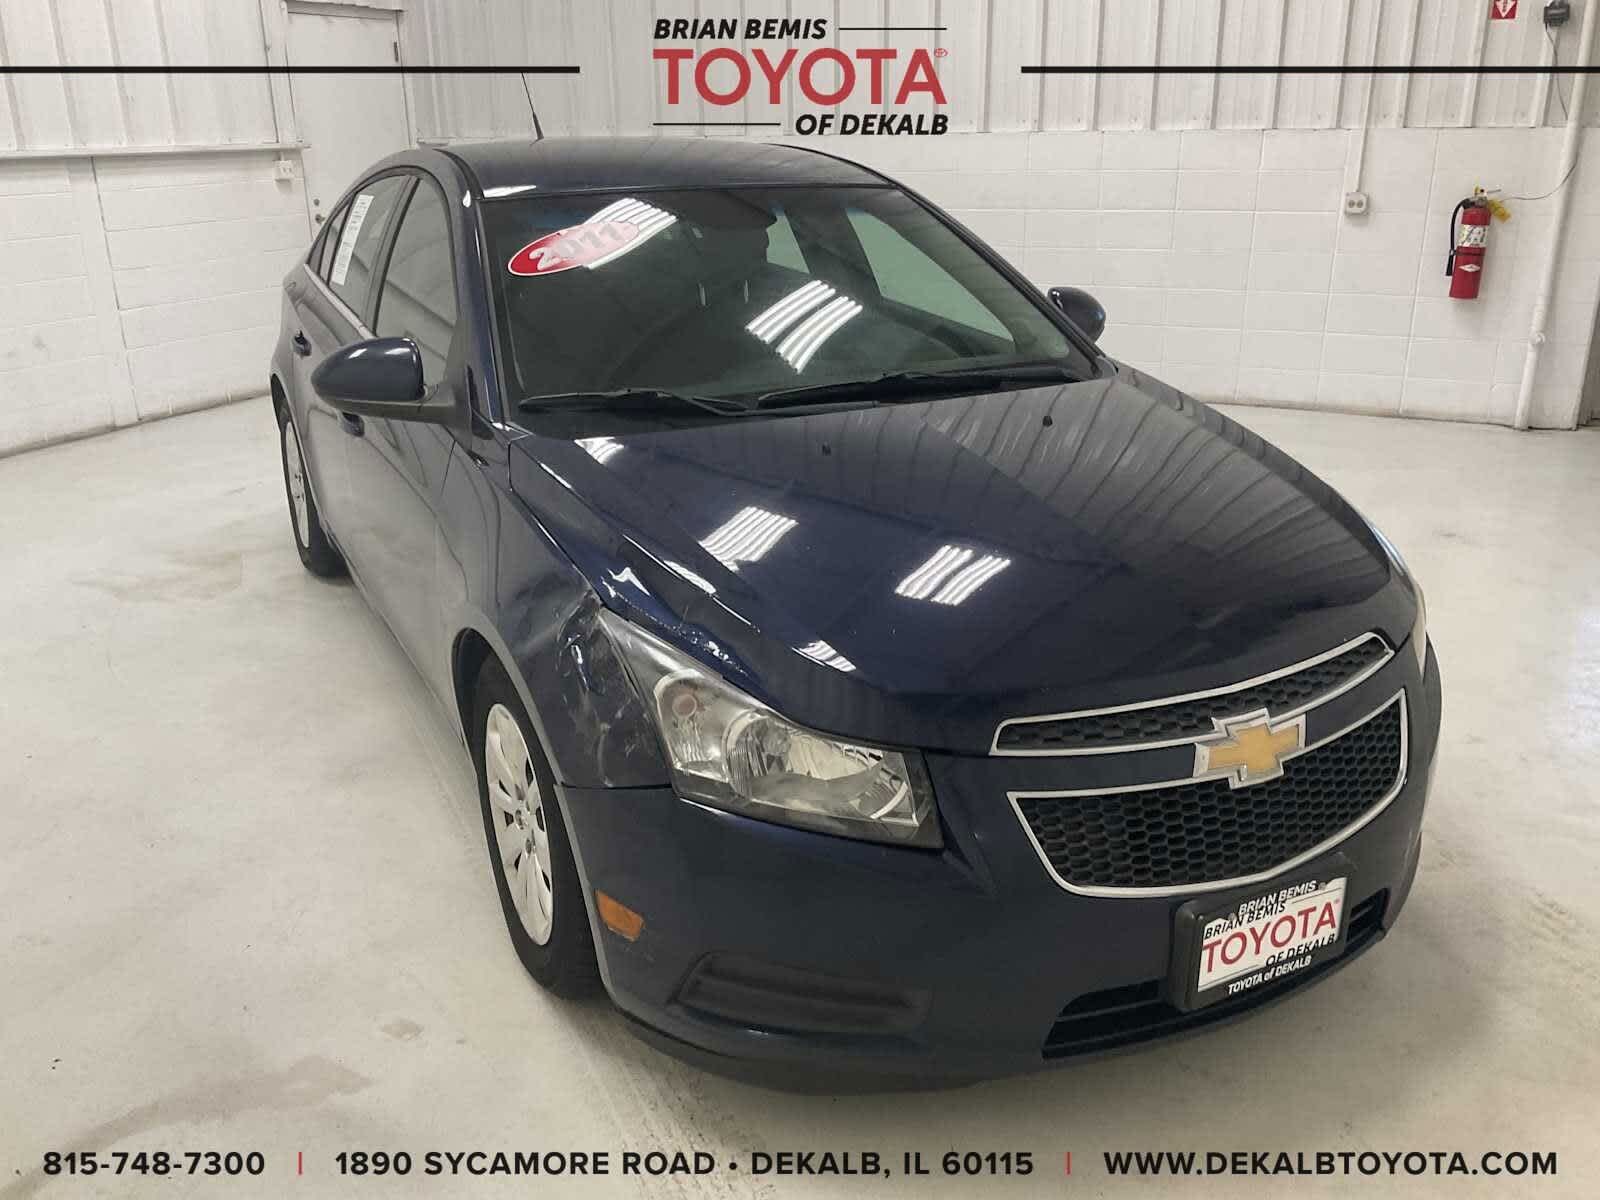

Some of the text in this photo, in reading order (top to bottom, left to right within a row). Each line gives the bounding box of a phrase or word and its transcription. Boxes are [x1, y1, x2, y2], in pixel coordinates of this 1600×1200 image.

[1238, 880, 1317, 915] BRIAN BEMIS
[1202, 901, 1337, 973] TOYOTA
[1204, 902, 1287, 940] BRIAN BEMIS
[1228, 955, 1313, 995] TOYOTA of DEKALB
